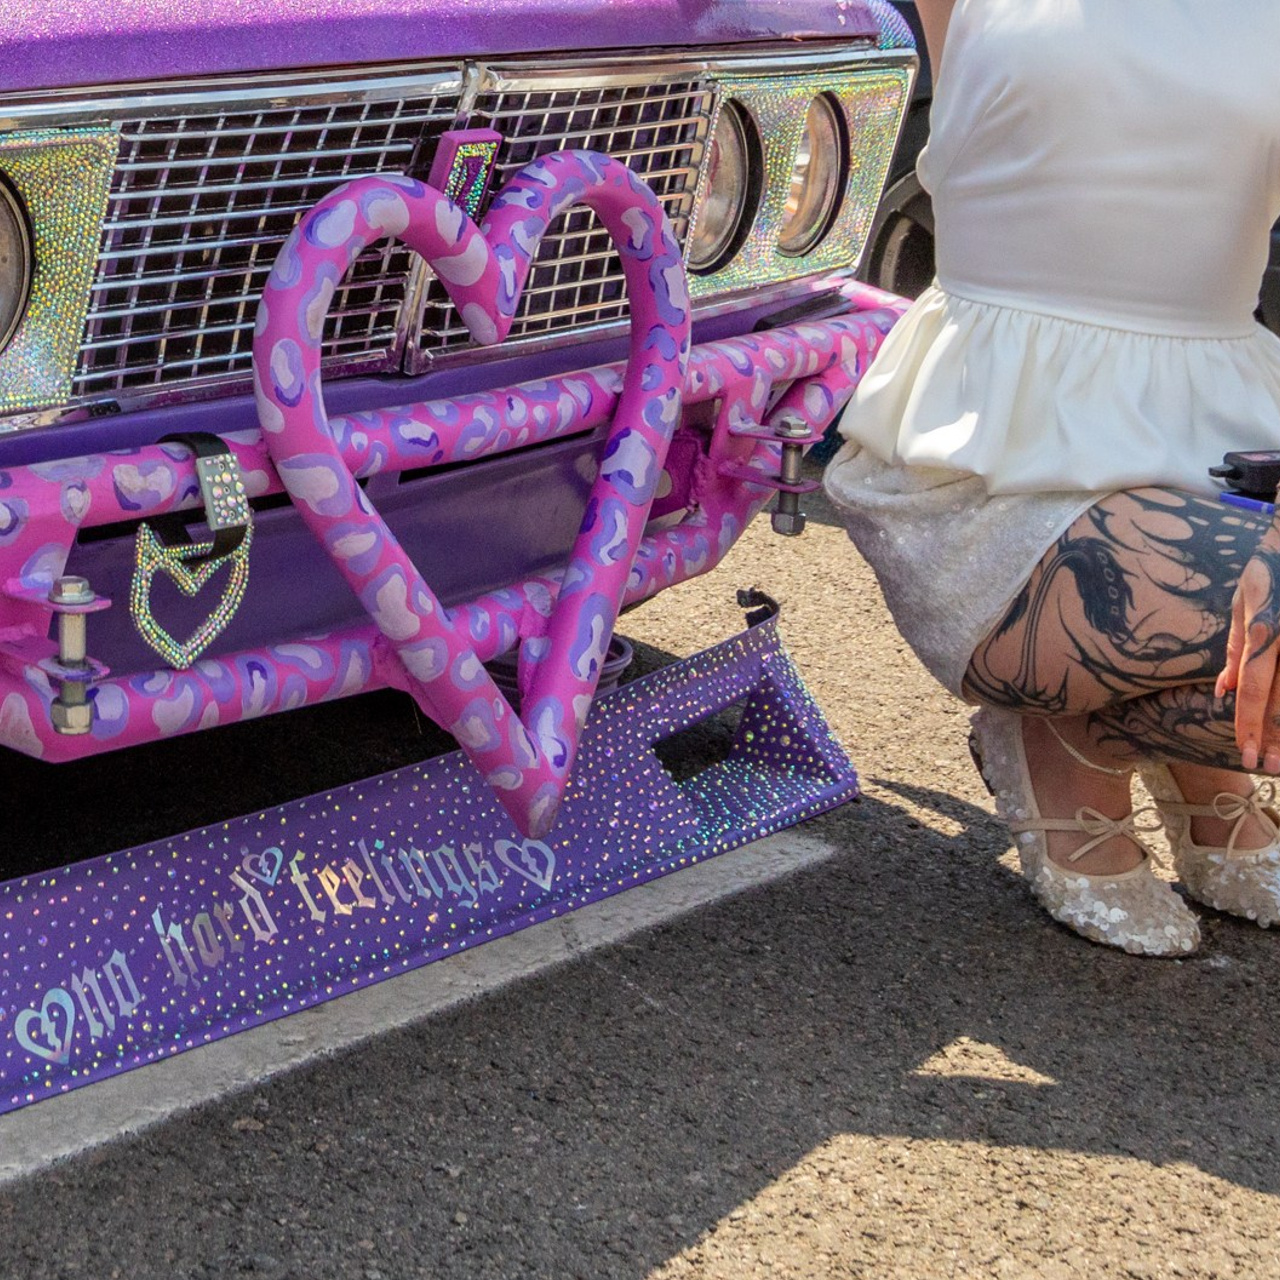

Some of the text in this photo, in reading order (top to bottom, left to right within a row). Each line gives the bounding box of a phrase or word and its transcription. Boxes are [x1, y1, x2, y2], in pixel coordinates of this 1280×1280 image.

[71, 837, 502, 1038] no hard feelings
